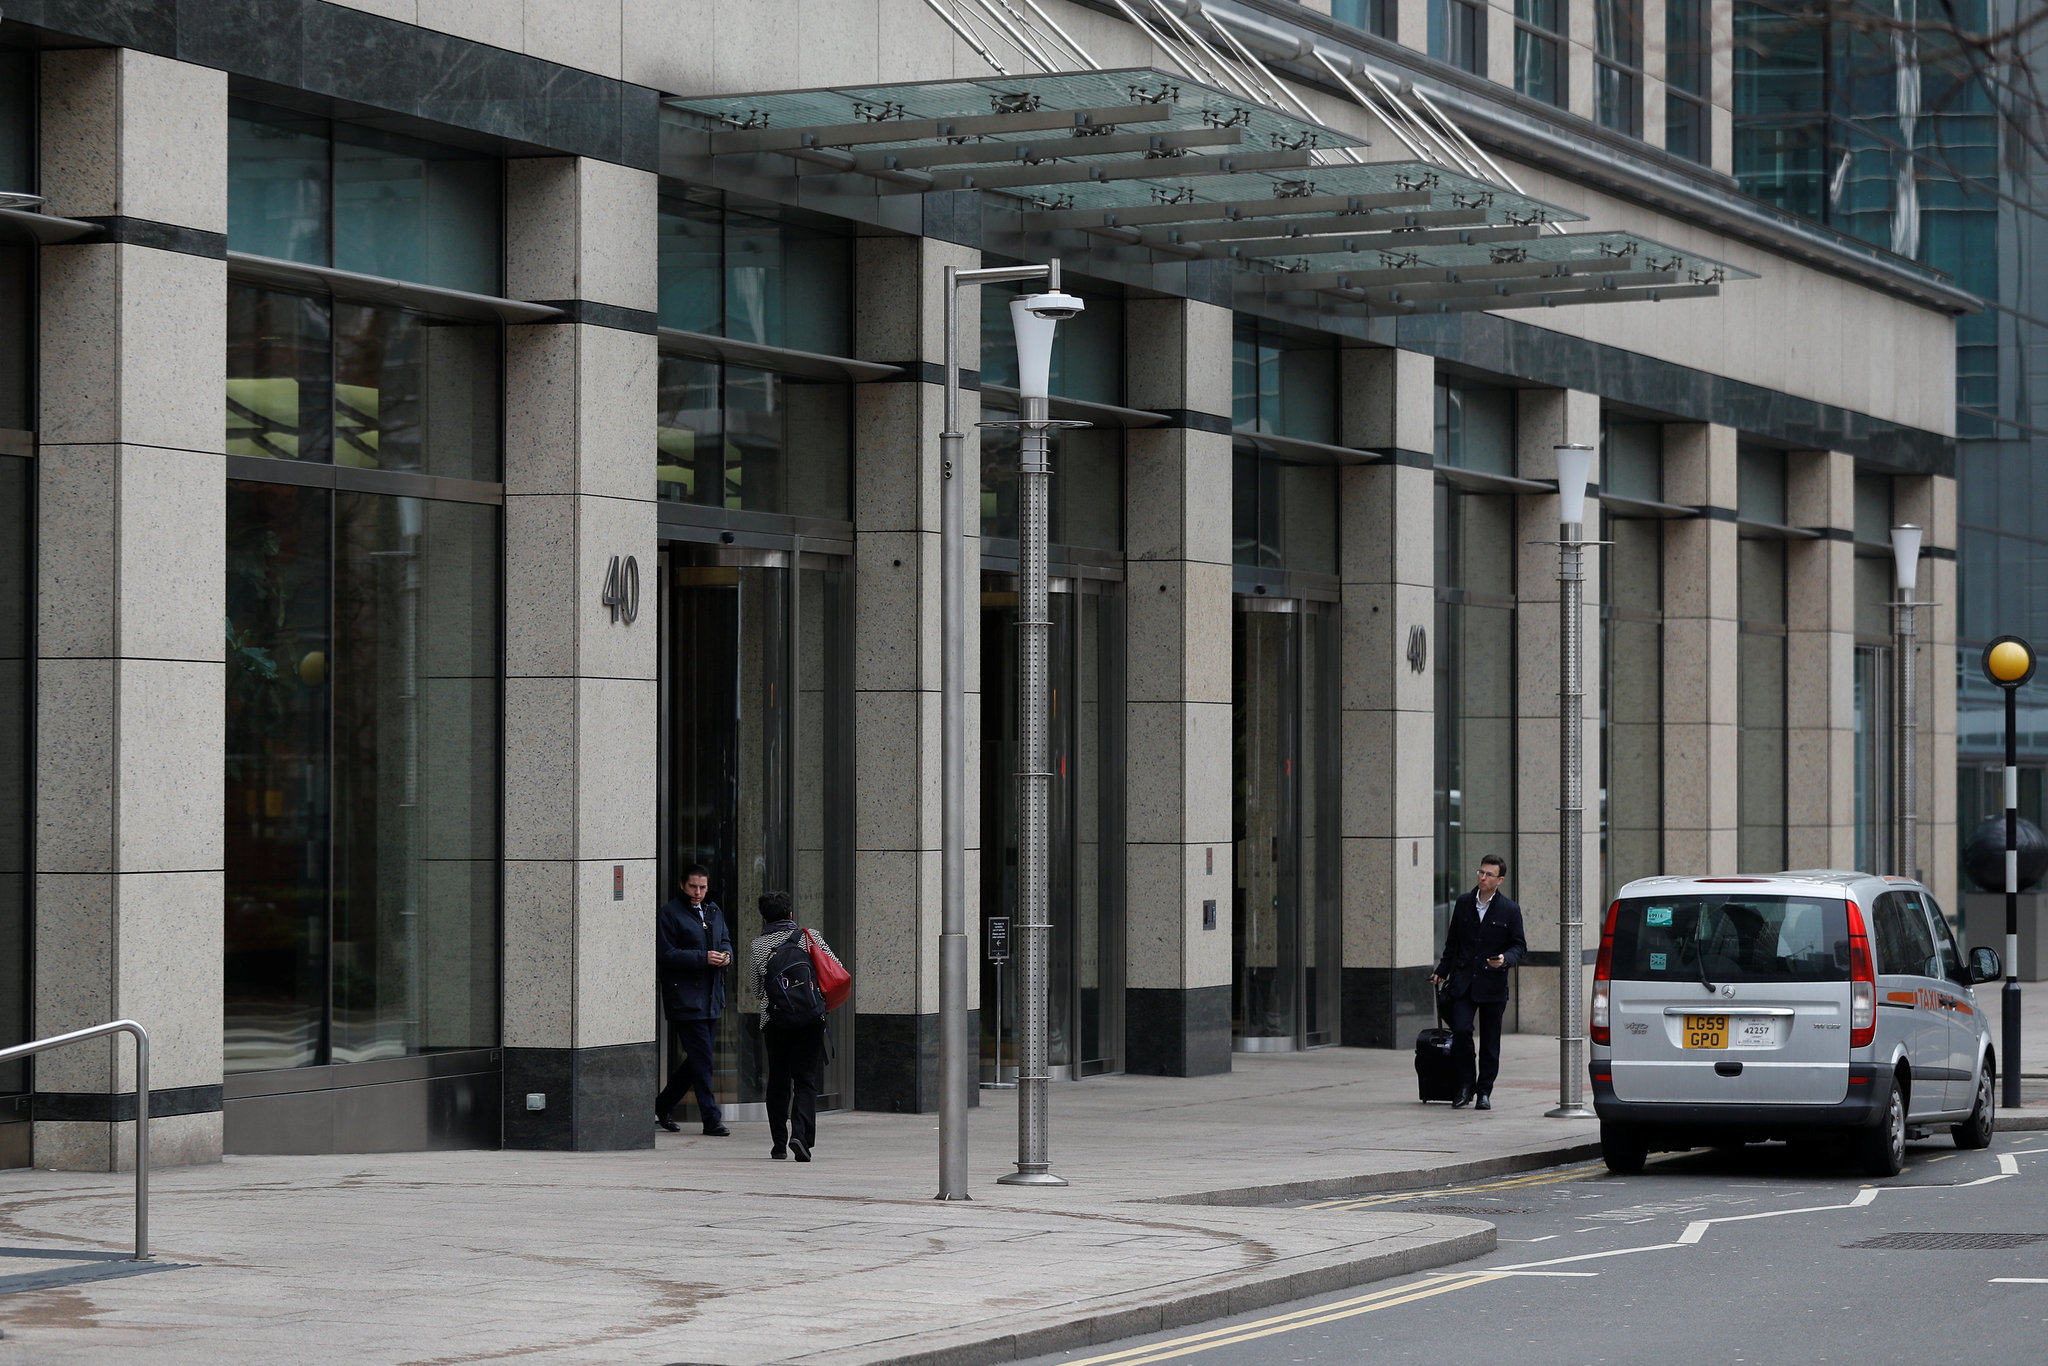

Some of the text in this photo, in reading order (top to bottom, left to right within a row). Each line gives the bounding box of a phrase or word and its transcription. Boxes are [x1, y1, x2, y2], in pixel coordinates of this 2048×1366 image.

[602, 555, 640, 624] 40
[1406, 624, 1427, 674] 40
[1917, 988, 1938, 1012] TAXI
[1686, 1016, 1725, 1031] LG59
[1743, 1026, 1770, 1035] 42257
[1690, 1032, 1720, 1047] GPO
